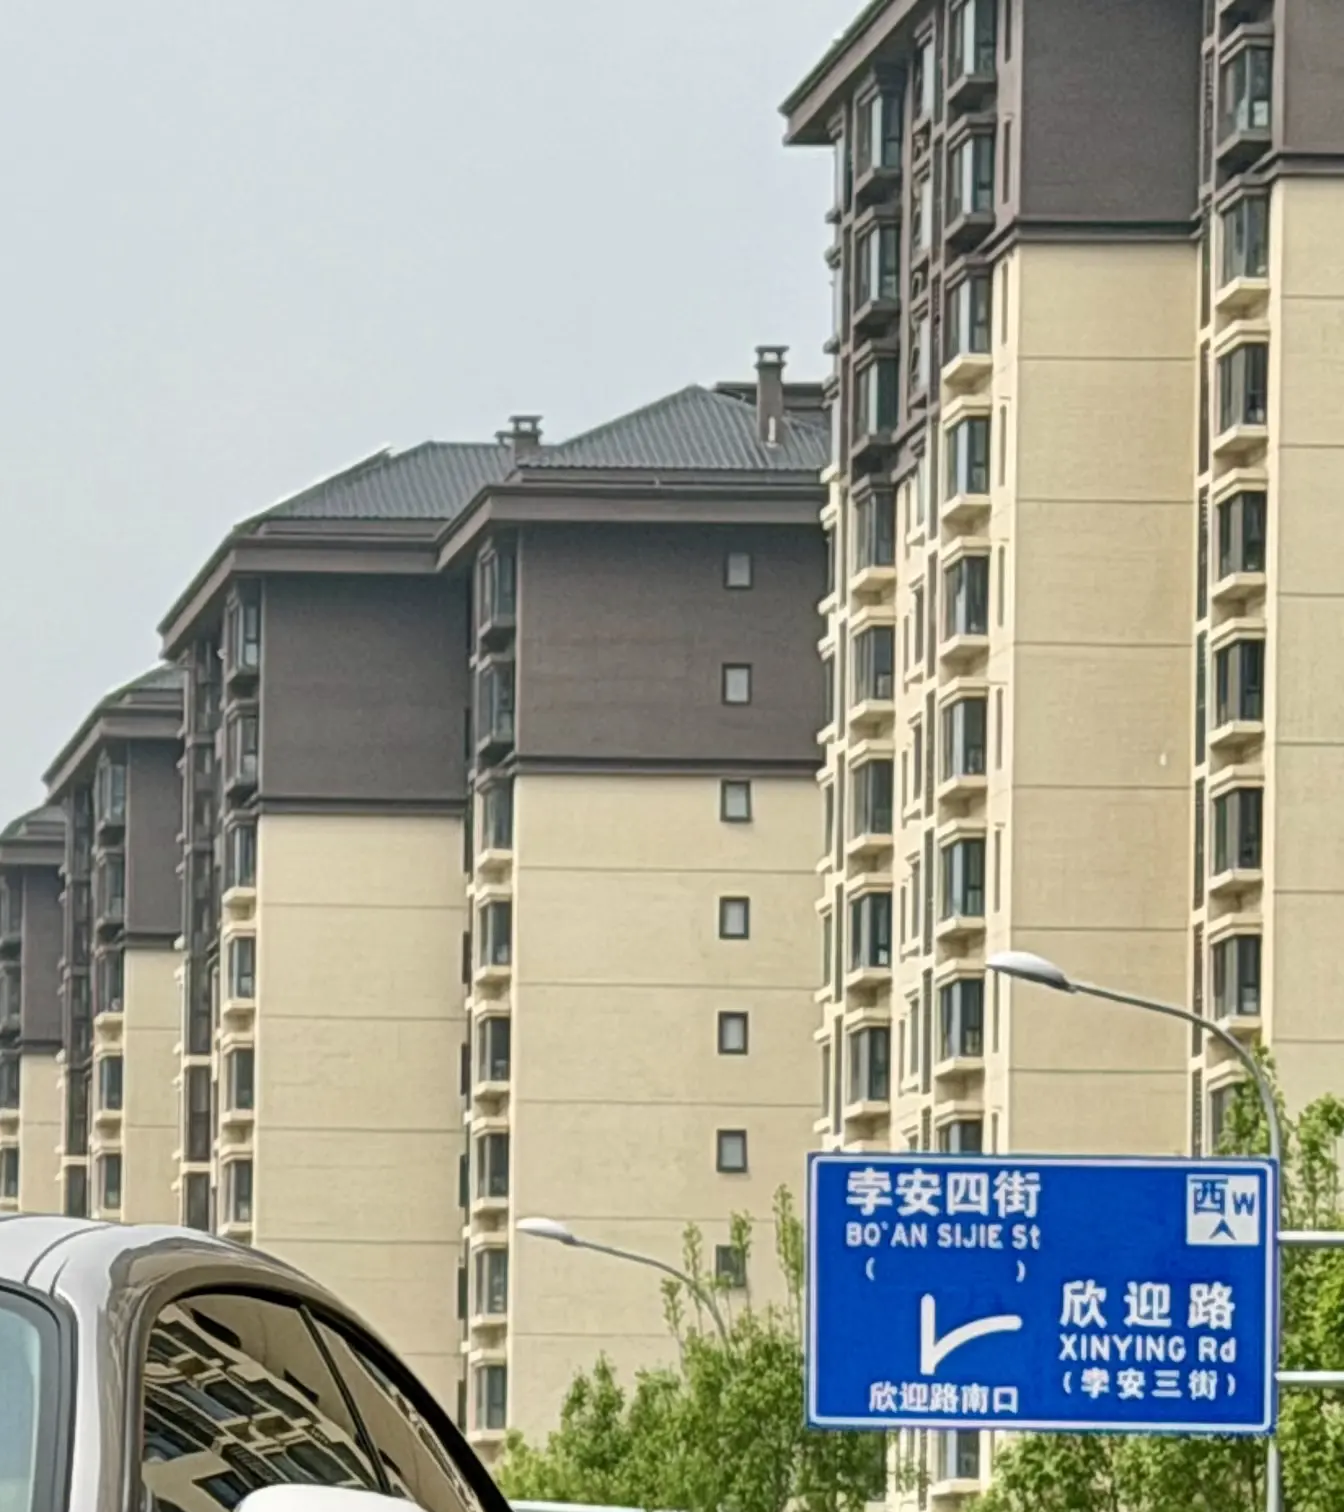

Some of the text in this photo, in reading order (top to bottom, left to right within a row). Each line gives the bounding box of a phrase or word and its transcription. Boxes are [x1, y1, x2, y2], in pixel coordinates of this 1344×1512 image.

[1191, 1178, 1228, 1216] 西
[1232, 1192, 1255, 1216] W
[846, 1222, 1040, 1250] BO'AN SIJIE St
[1059, 1279, 1236, 1331] 欣迎路
[1059, 1334, 1236, 1363] XINYING Rd
[868, 1381, 1019, 1415] 欣迎路南口
